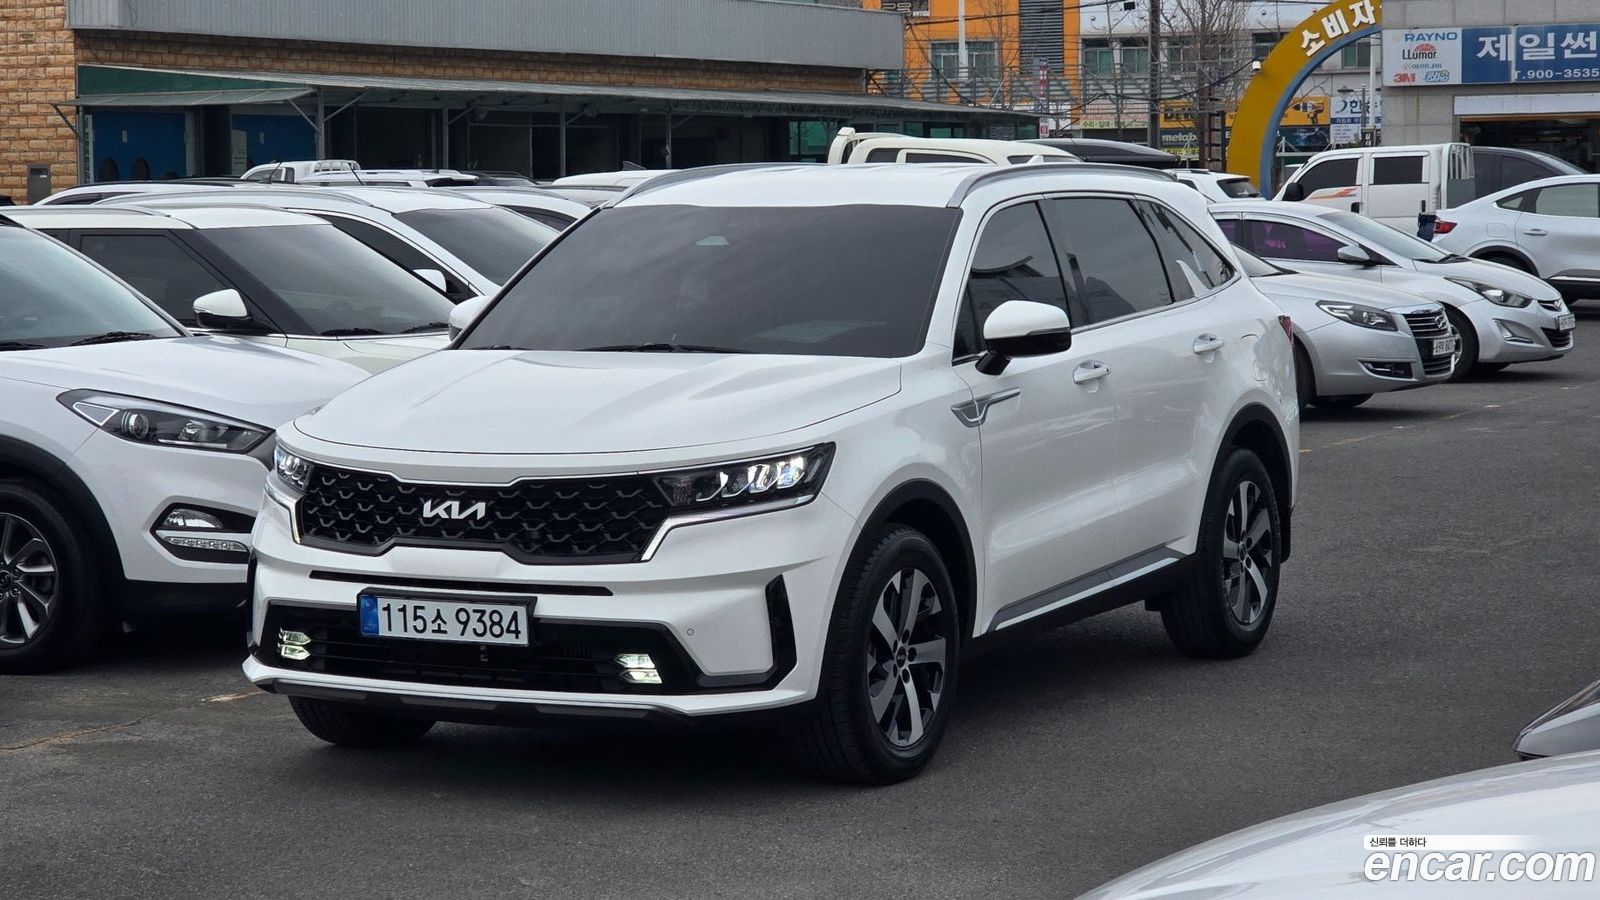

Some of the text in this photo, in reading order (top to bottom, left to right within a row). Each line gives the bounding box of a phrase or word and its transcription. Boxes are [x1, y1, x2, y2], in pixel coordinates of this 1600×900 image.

[1404, 32, 1458, 42] RAYNO
[1476, 30, 1599, 62] 제일썬
[1402, 49, 1438, 60] LLumar
[1392, 72, 1416, 83] 3M
[1161, 132, 1198, 142] metab
[422, 499, 486, 520] KIA
[382, 602, 522, 640] 115소 9384
